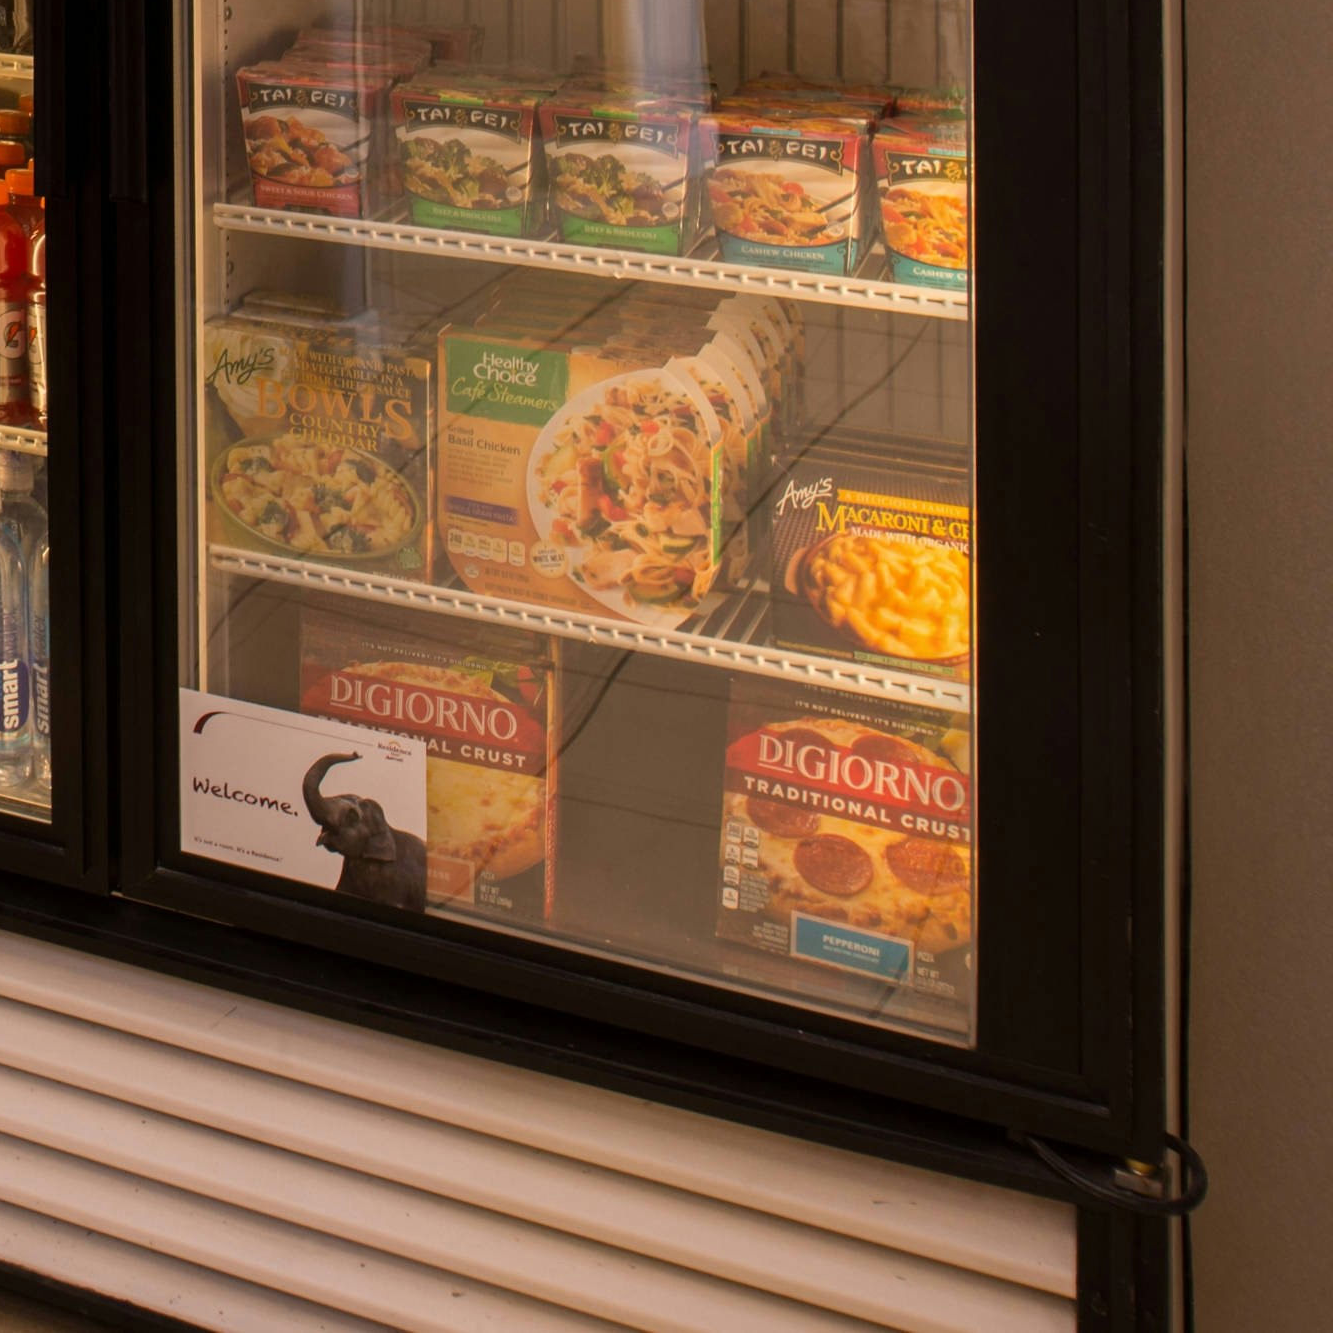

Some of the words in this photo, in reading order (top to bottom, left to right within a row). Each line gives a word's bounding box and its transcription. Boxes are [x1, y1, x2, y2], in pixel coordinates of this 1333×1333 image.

[311, 91, 346, 107] PEI
[417, 108, 450, 122] TAI
[470, 112, 507, 128] PEI
[568, 121, 603, 137] TAI
[625, 125, 663, 143] PEI
[726, 139, 764, 155] TAI
[787, 141, 827, 159] PEI
[901, 160, 941, 176] TAI
[742, 245, 779, 259] CASHEW
[783, 248, 826, 262] CHICKEN
[913, 266, 954, 280] CASHEW
[206, 348, 275, 384] Amy's
[483, 351, 539, 373] Healthy
[473, 363, 537, 387] Choice
[451, 377, 485, 402] Café
[487, 382, 559, 411] Steamers
[256, 377, 413, 440] BOWLS
[290, 413, 380, 437] COUNTRY
[289, 427, 378, 452] CHEDDAR
[448, 434, 473, 448] Basil
[476, 439, 520, 456] Chicken
[776, 477, 833, 516] Amy's
[816, 502, 929, 537] MACARONI
[932, 520, 946, 536] &
[851, 526, 884, 541] MADE
[885, 532, 917, 546] WITH
[0, 659, 19, 730] smart
[330, 675, 518, 742] DIGIORNO
[812, 703, 828, 714] NOT
[461, 745, 527, 768] CRUST
[758, 734, 966, 812] DIGIORNO
[193, 777, 298, 817] Welcome.
[744, 775, 891, 824] TRADITIONAL
[901, 814, 970, 841] CRUST
[822, 933, 880, 957] PEPPERONI
